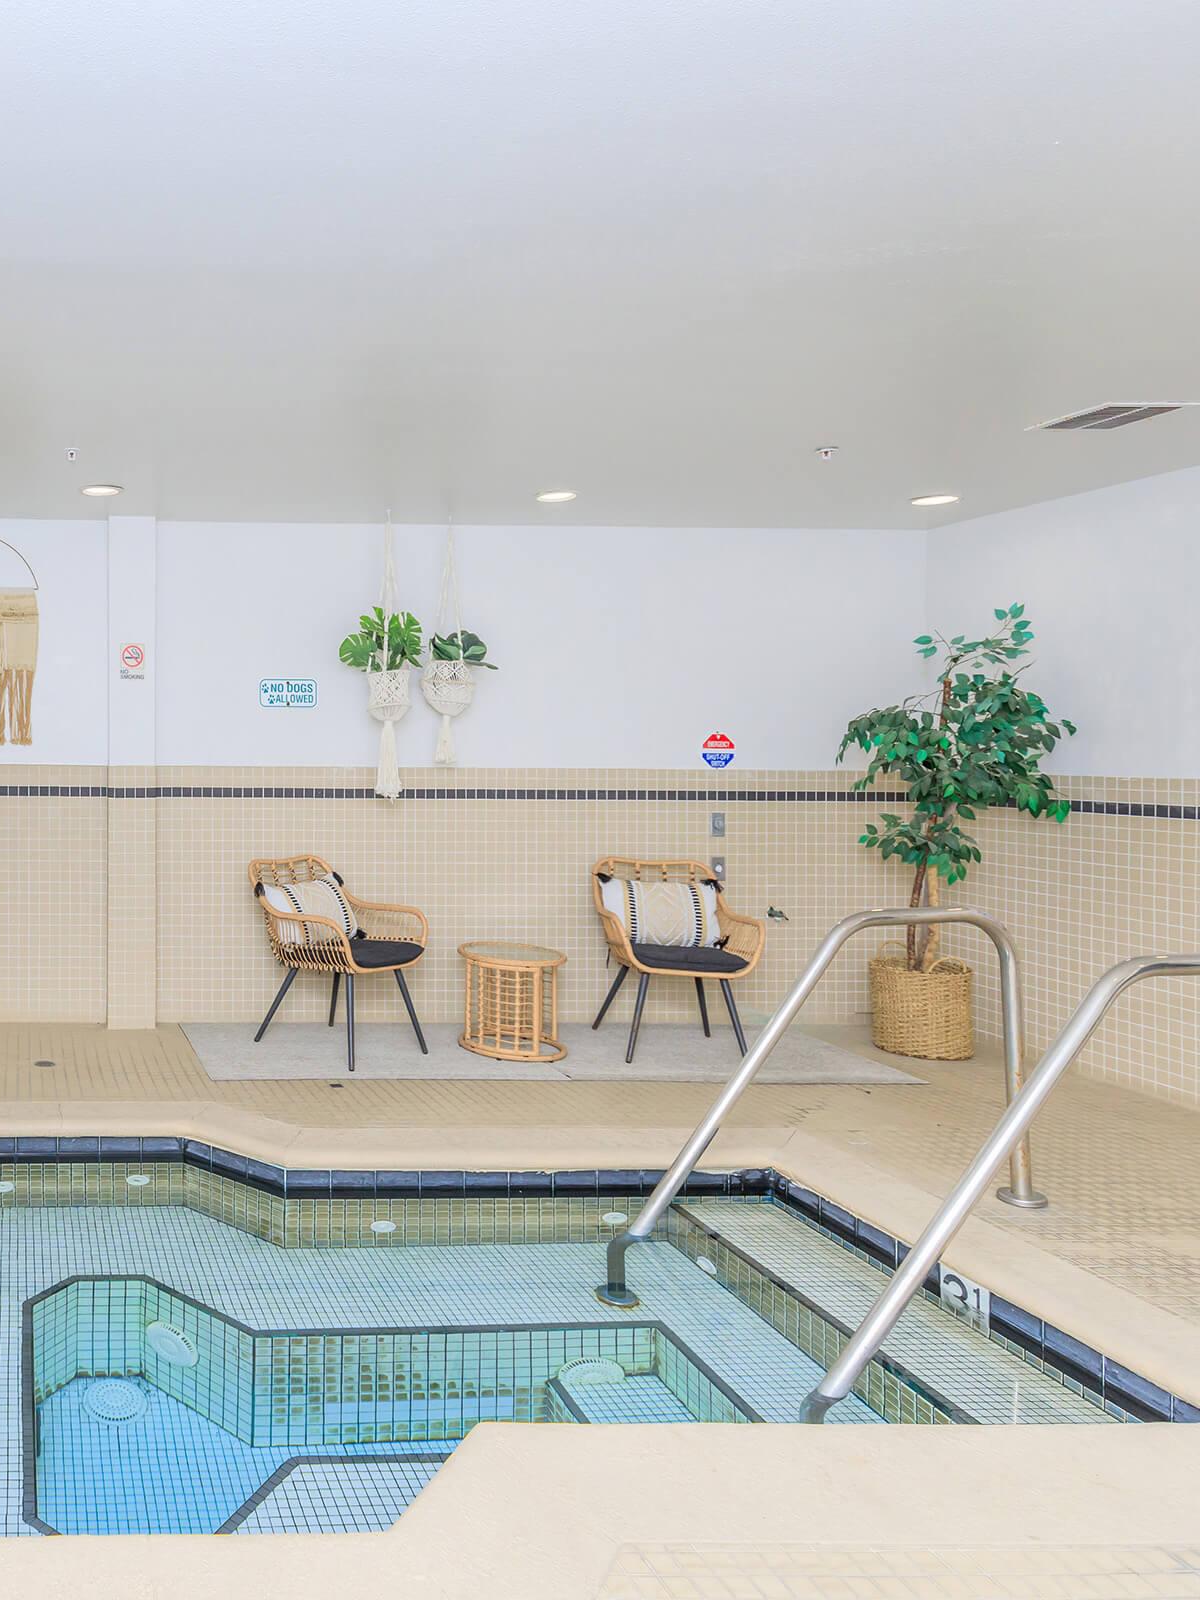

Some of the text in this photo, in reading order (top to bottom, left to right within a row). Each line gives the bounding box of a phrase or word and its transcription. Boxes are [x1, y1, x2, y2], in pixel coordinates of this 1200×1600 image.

[270, 683, 313, 693] NO DOGS
[275, 694, 314, 704] ALLOWED
